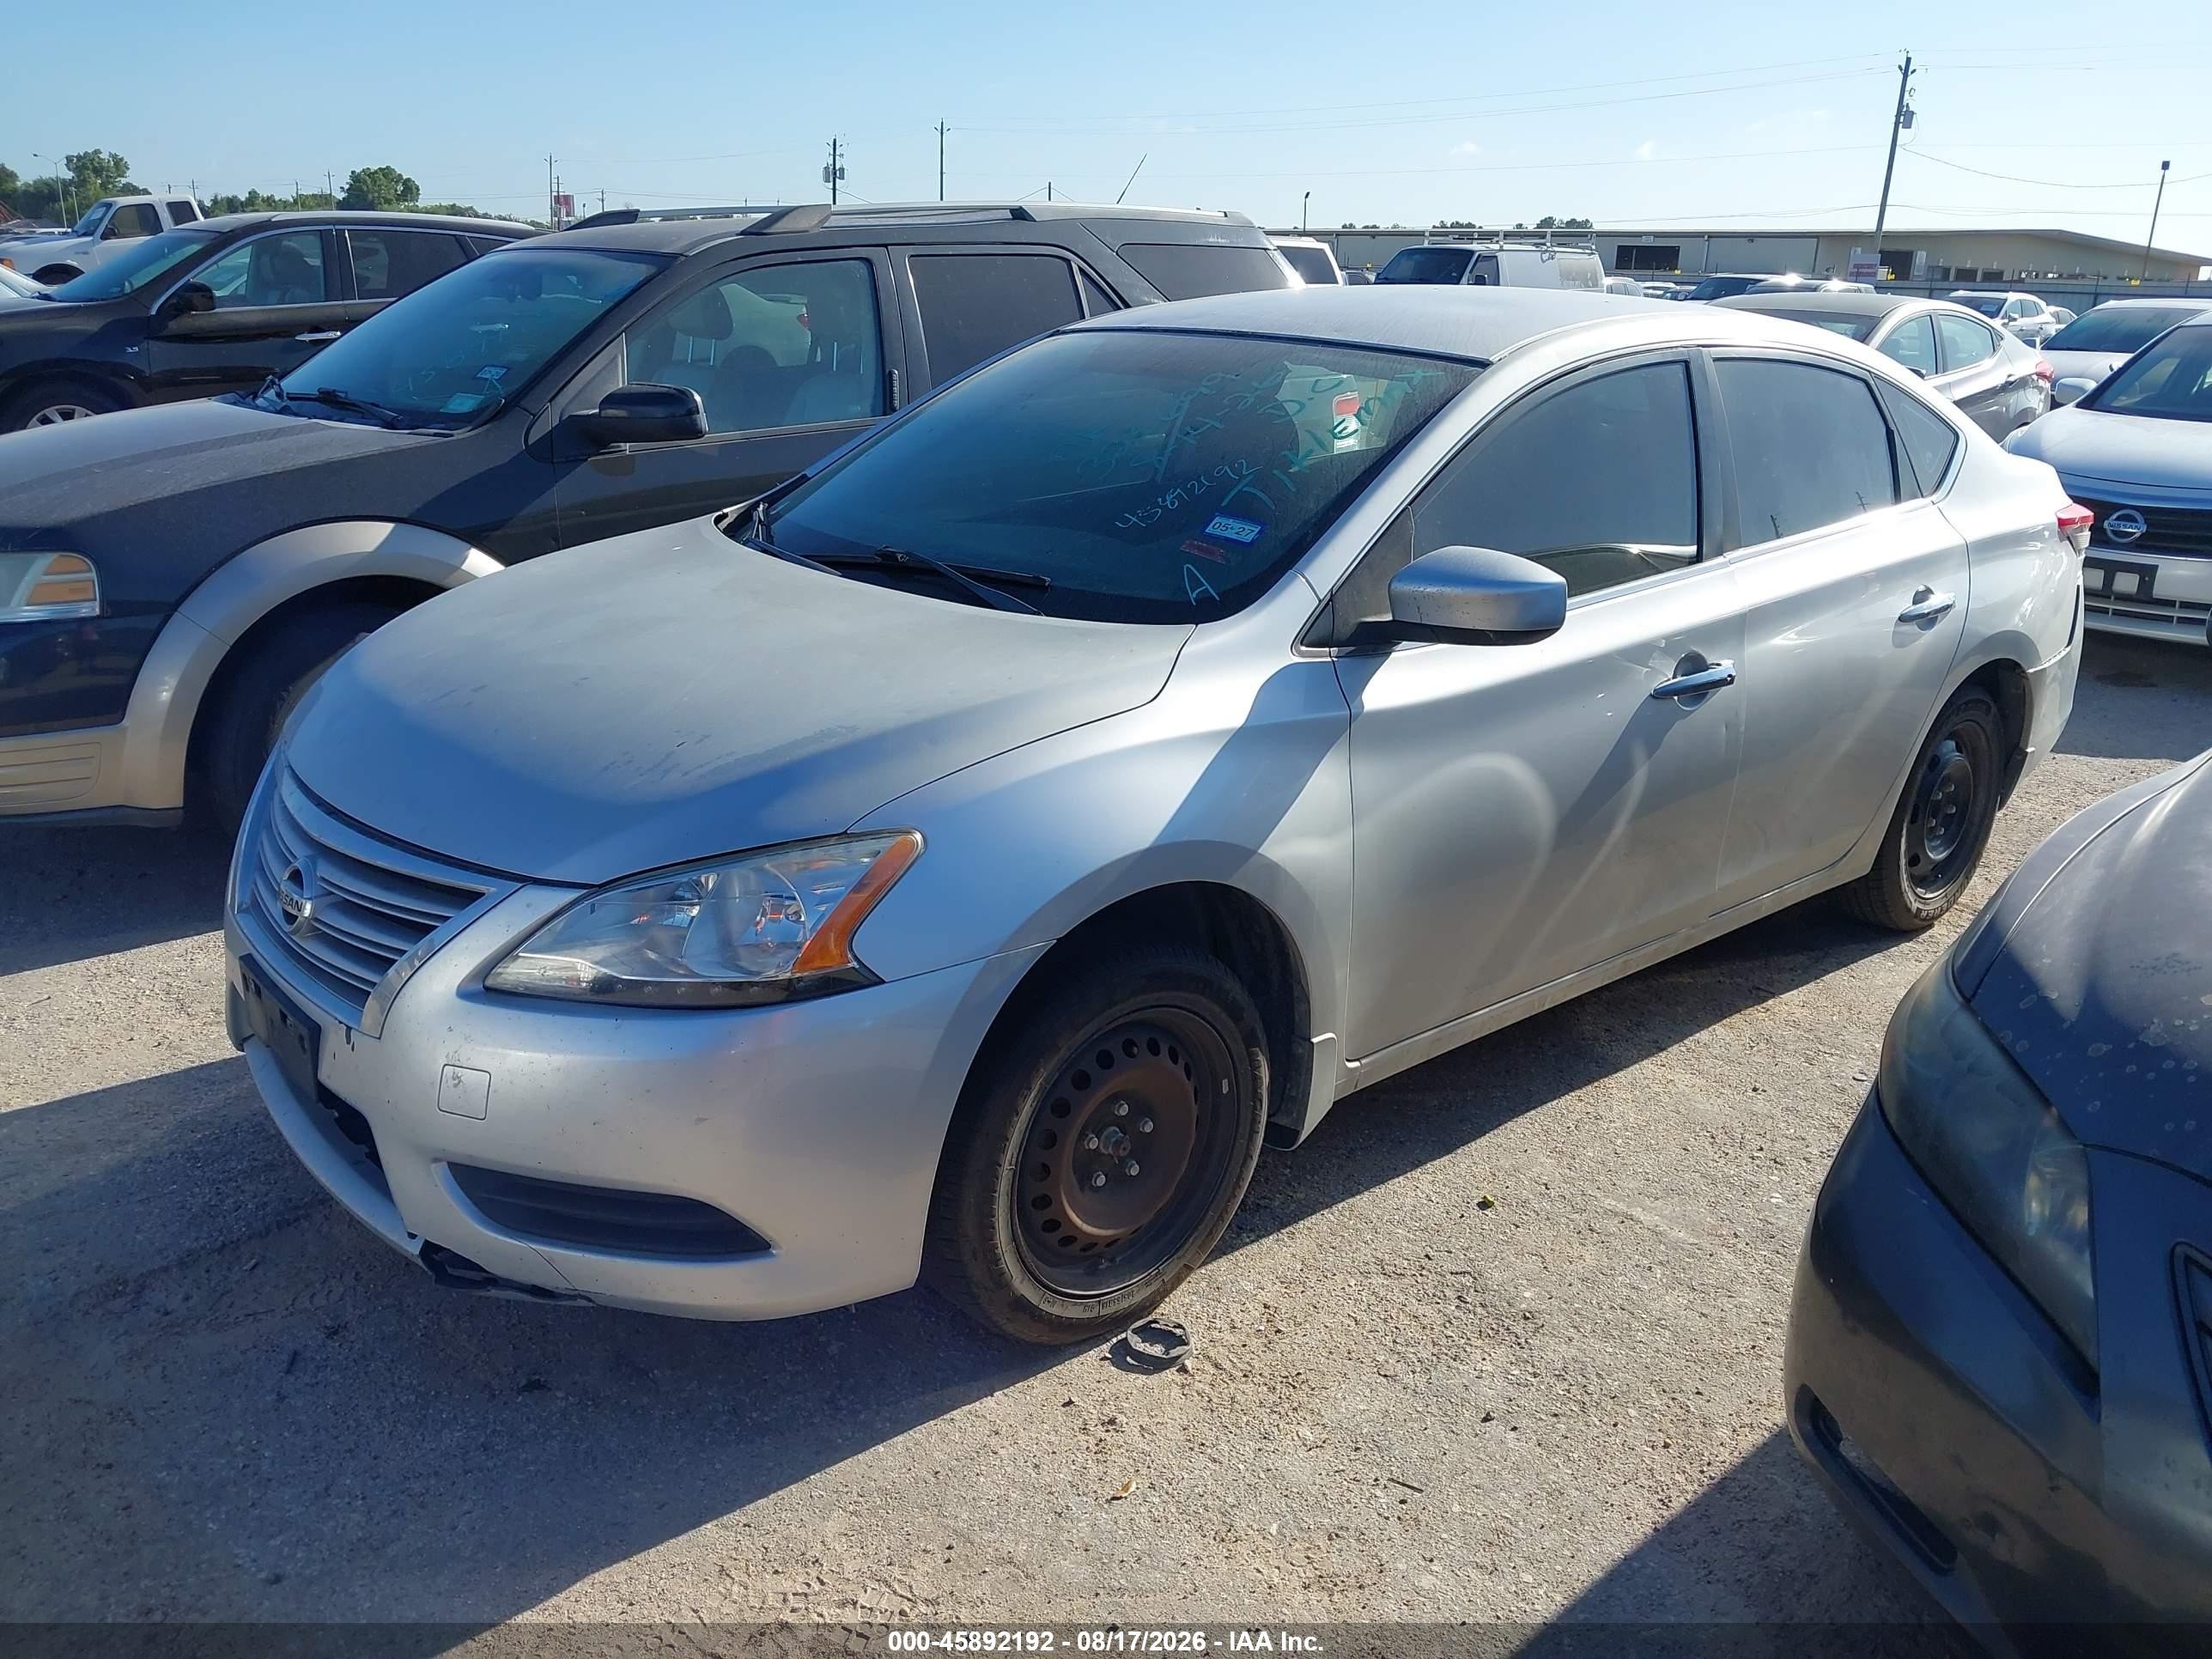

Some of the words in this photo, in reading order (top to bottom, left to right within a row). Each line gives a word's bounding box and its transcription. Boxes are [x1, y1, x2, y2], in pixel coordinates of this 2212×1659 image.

[2107, 521, 2142, 531] NISSAN
[1182, 563, 1221, 606] A
[279, 890, 304, 913] SSAN
